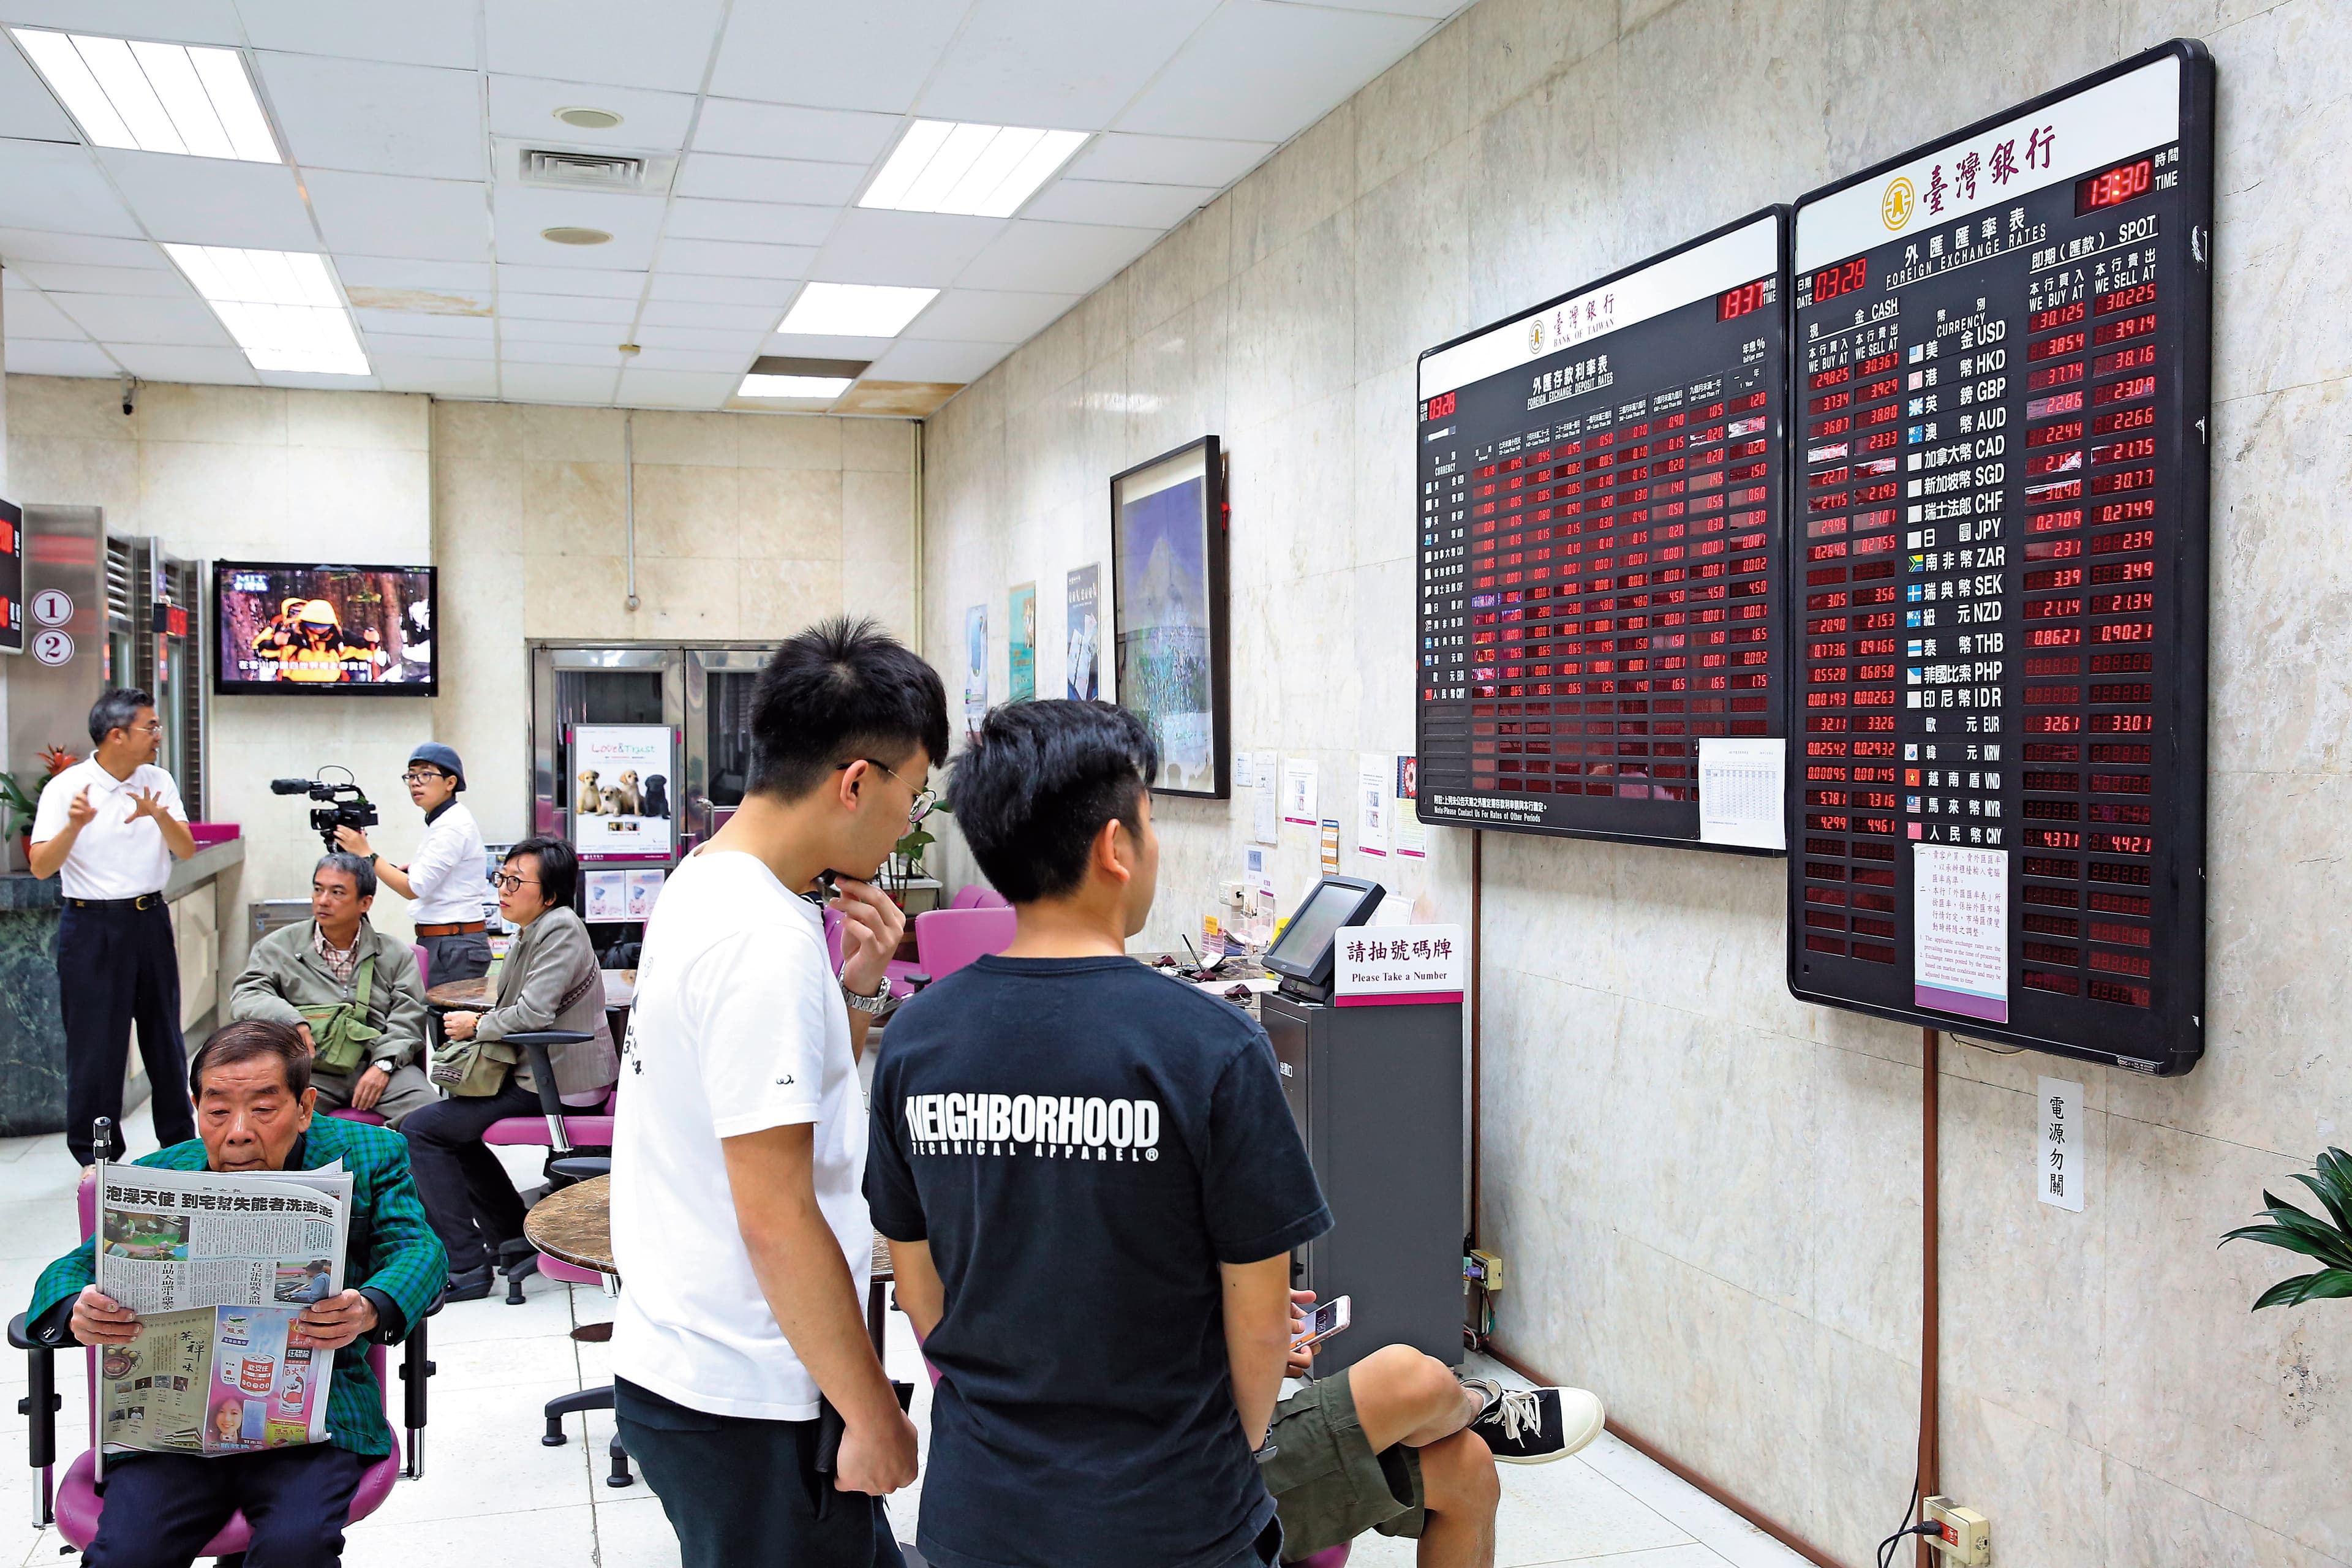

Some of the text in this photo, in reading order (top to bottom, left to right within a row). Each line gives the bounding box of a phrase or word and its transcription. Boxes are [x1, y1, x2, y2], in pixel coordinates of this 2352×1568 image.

[2154, 147, 2179, 168] 時間
[1923, 125, 2056, 216] 臺灣銀行
[2155, 170, 2178, 191] TIME
[2090, 160, 2150, 206] 13:30
[1905, 207, 2025, 268] 外匯匯率表
[2119, 214, 2156, 243] SPOT
[1886, 223, 2046, 288] FOREIGN EXCHANGE RATES
[2095, 247, 2156, 277] 本行賣出
[1763, 277, 1776, 292] 時間
[1797, 276, 1812, 291] 日期
[1815, 258, 1866, 302] 0328
[2029, 269, 2084, 296] 本行買入
[2095, 264, 2156, 295] WE SELL AT
[1763, 290, 1776, 305] TIME
[1796, 293, 1812, 309] DATE
[1871, 297, 1898, 320] CASH
[2029, 284, 2084, 312] WE BUY AT
[1554, 293, 1615, 335] 臺灣銀行
[1937, 312, 1986, 337] CURRENCY
[1554, 317, 1615, 348] BANK OF TAIWAN
[1855, 323, 1898, 345] 本行賣出
[1977, 319, 2006, 345] USD
[1808, 337, 1849, 360] 本行買入
[1855, 337, 1898, 361] WE SELL AT
[1809, 351, 1849, 374] WE BUY AT
[1976, 349, 2006, 375] HKD
[1532, 353, 1608, 396] 外匯存款利率表
[1527, 371, 1613, 409] FOREIGN EXCHANGE DEPOSIT RATES
[1977, 377, 2006, 402] GBP
[1976, 407, 2006, 431] AUD
[1924, 442, 1972, 469] 加拿大幣
[1975, 434, 2005, 459] CAD
[1924, 462, 2005, 496] 新加坡幣 SGD
[1924, 490, 2003, 521] 瑞士法郎 CHF
[1975, 517, 2002, 541] JPY
[1977, 546, 2005, 568] ZAR
[1975, 573, 2003, 597] SEK
[45, 598, 59, 618] 1
[1974, 601, 2002, 623] NZD
[45, 636, 61, 658] 2
[1975, 632, 2004, 654] THB
[1924, 661, 2003, 685] 菲國比索 PHP
[1974, 687, 2002, 708] IDR
[1983, 715, 2000, 733] EUR
[1984, 744, 2000, 761] KRW
[1985, 772, 2000, 790] VND
[1458, 808, 1473, 817] Contact
[1490, 810, 1502, 820] Rates
[1510, 812, 1523, 821] Other
[1524, 813, 1541, 823] Periods
[1985, 799, 2001, 818] MYR
[1986, 827, 2002, 845] CNY
[1346, 938, 1452, 963] 請抽號碼牌
[1352, 973, 1379, 982] Please
[1382, 972, 1402, 981] Take
[1414, 971, 1447, 981] Number
[905, 1092, 1159, 1148] NEIGHBORHOOD
[911, 1141, 1016, 1156] TECHNICAL
[2048, 1096, 2065, 1198] 電源勿關
[105, 1185, 175, 1208] 泡澡天使
[181, 1193, 334, 1218] 到宅幫失能者洗澎澎
